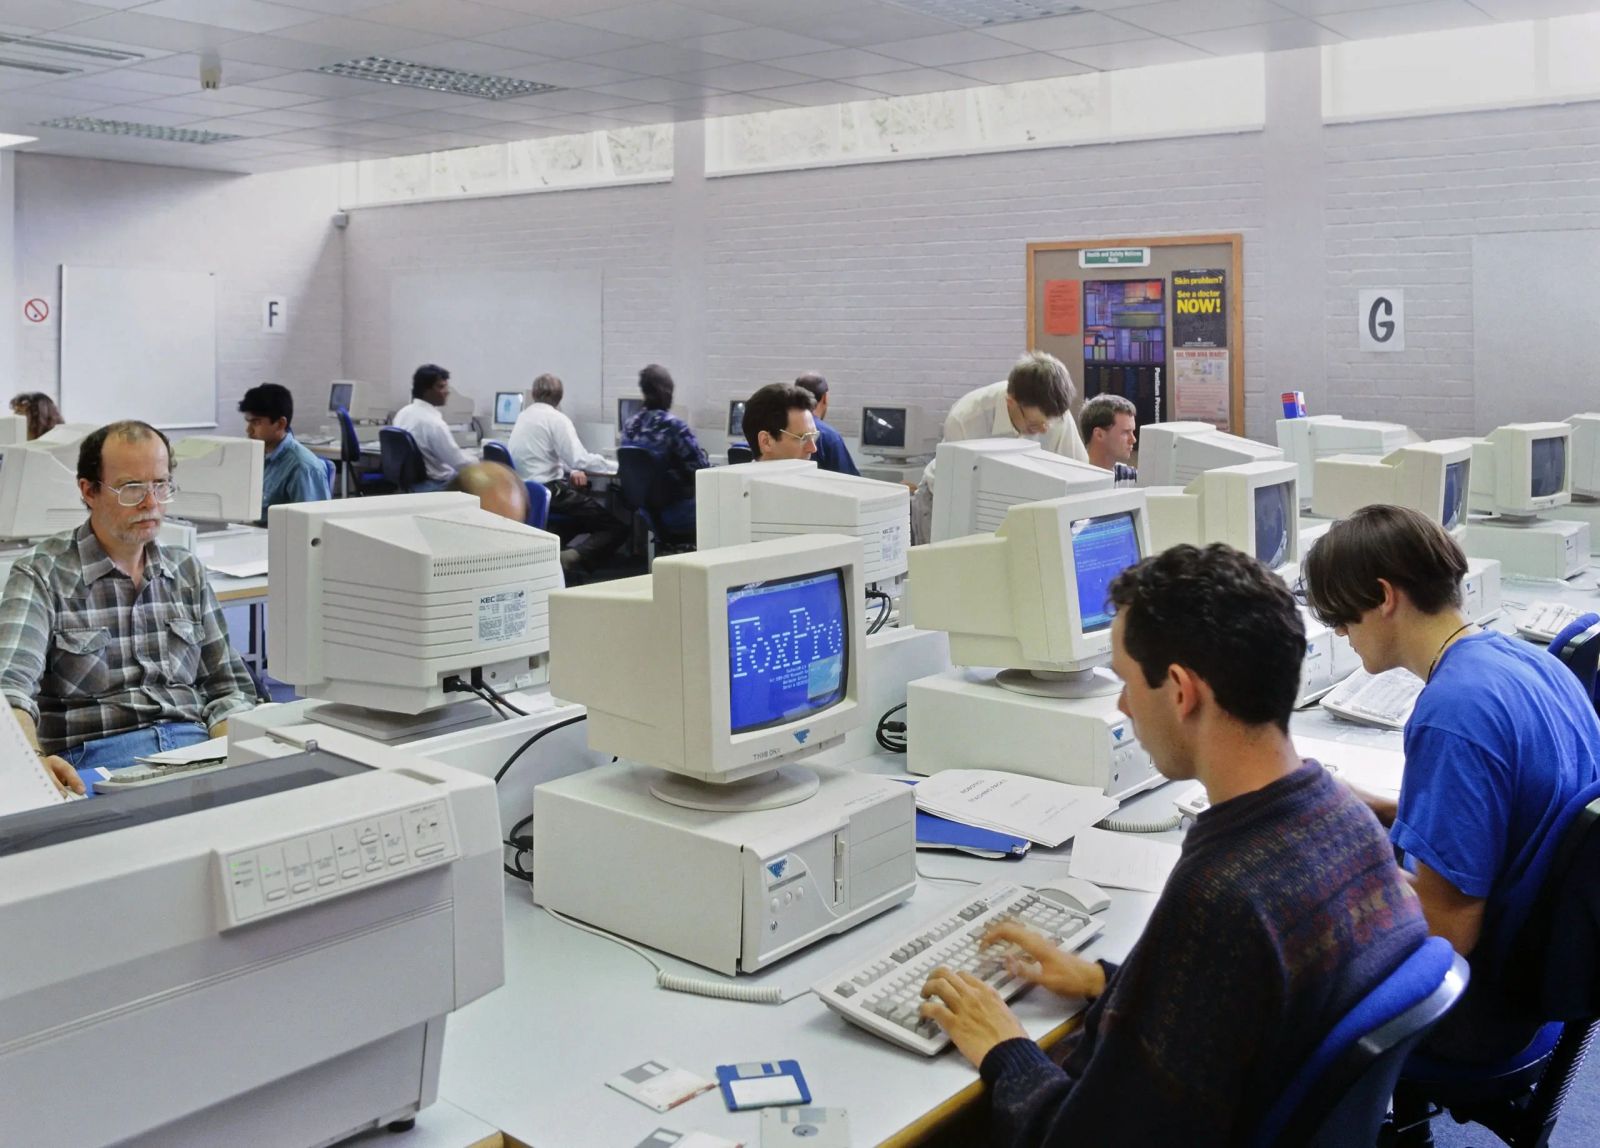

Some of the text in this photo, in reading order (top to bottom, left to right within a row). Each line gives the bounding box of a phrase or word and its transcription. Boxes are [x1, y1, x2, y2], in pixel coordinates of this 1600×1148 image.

[1174, 275, 1224, 286] Skin problem?
[1177, 290, 1191, 298] See
[1197, 290, 1220, 298] doctor
[268, 300, 279, 328] F
[1177, 298, 1221, 314] NOW!
[1368, 296, 1396, 343] G
[730, 607, 843, 678] FoxPro
